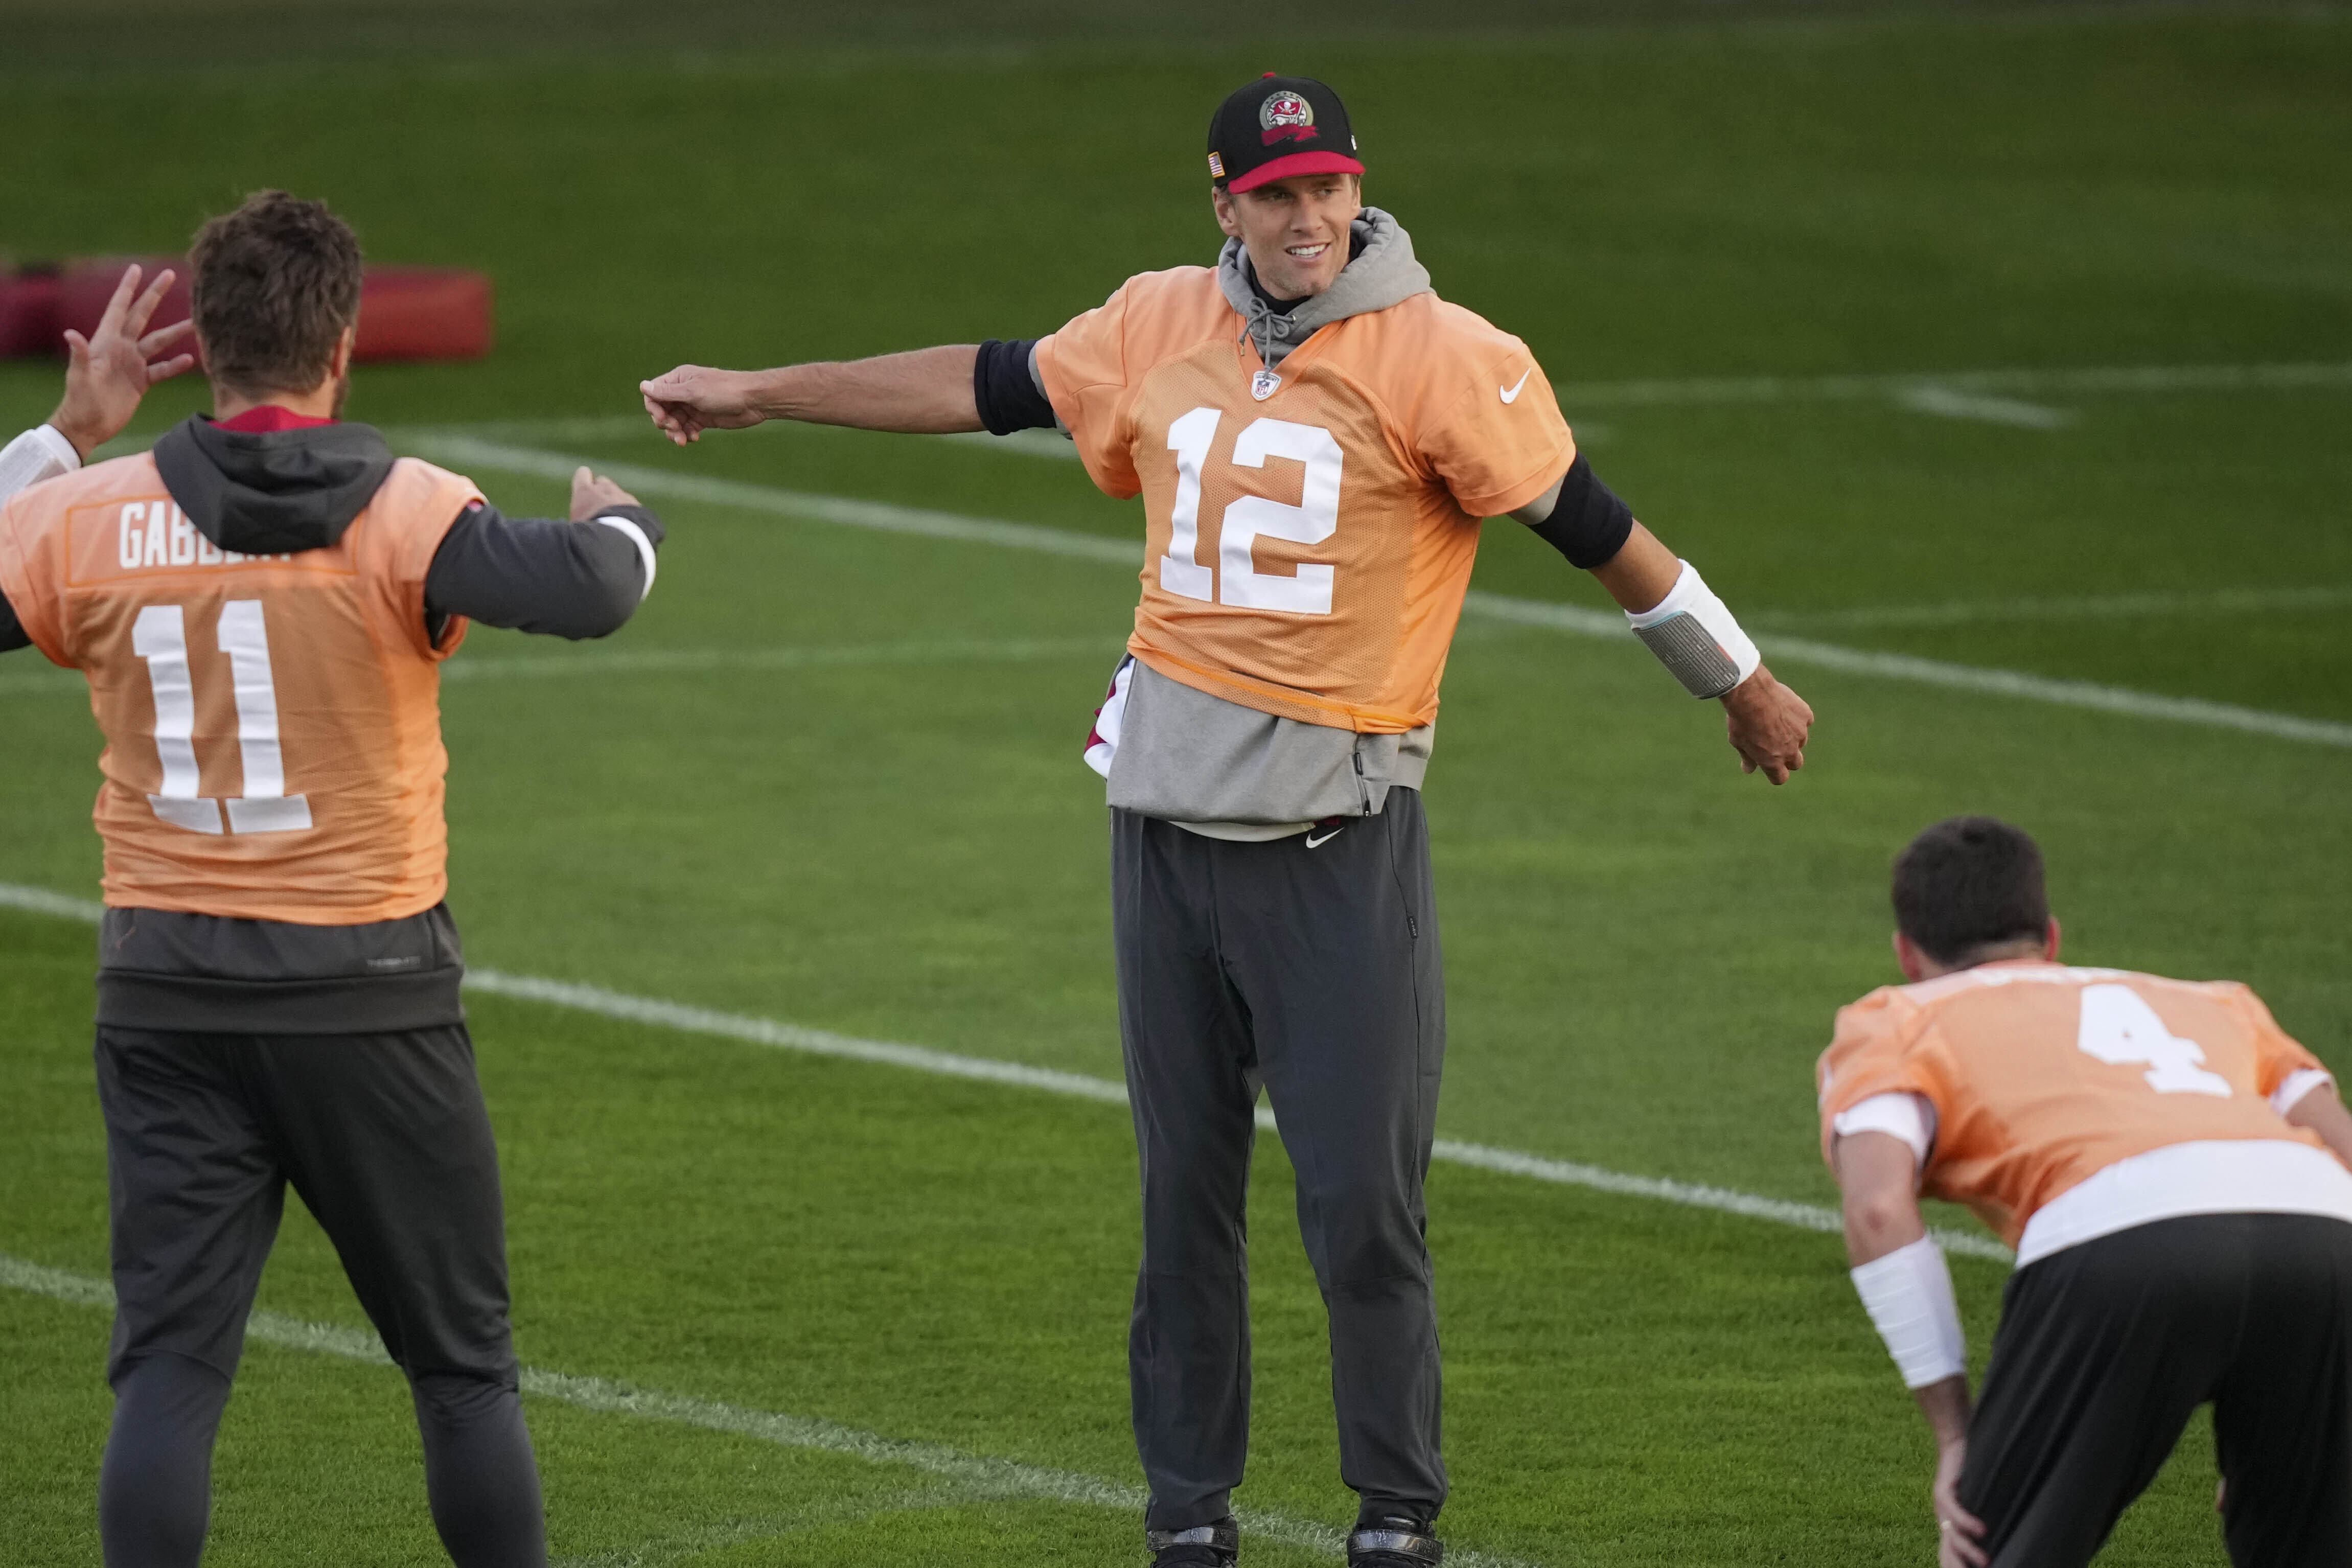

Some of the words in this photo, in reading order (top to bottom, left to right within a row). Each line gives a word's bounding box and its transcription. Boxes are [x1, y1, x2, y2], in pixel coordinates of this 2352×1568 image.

[1161, 407, 1343, 614] 12
[132, 599, 312, 834] 11
[2078, 983, 2232, 1098] 4
